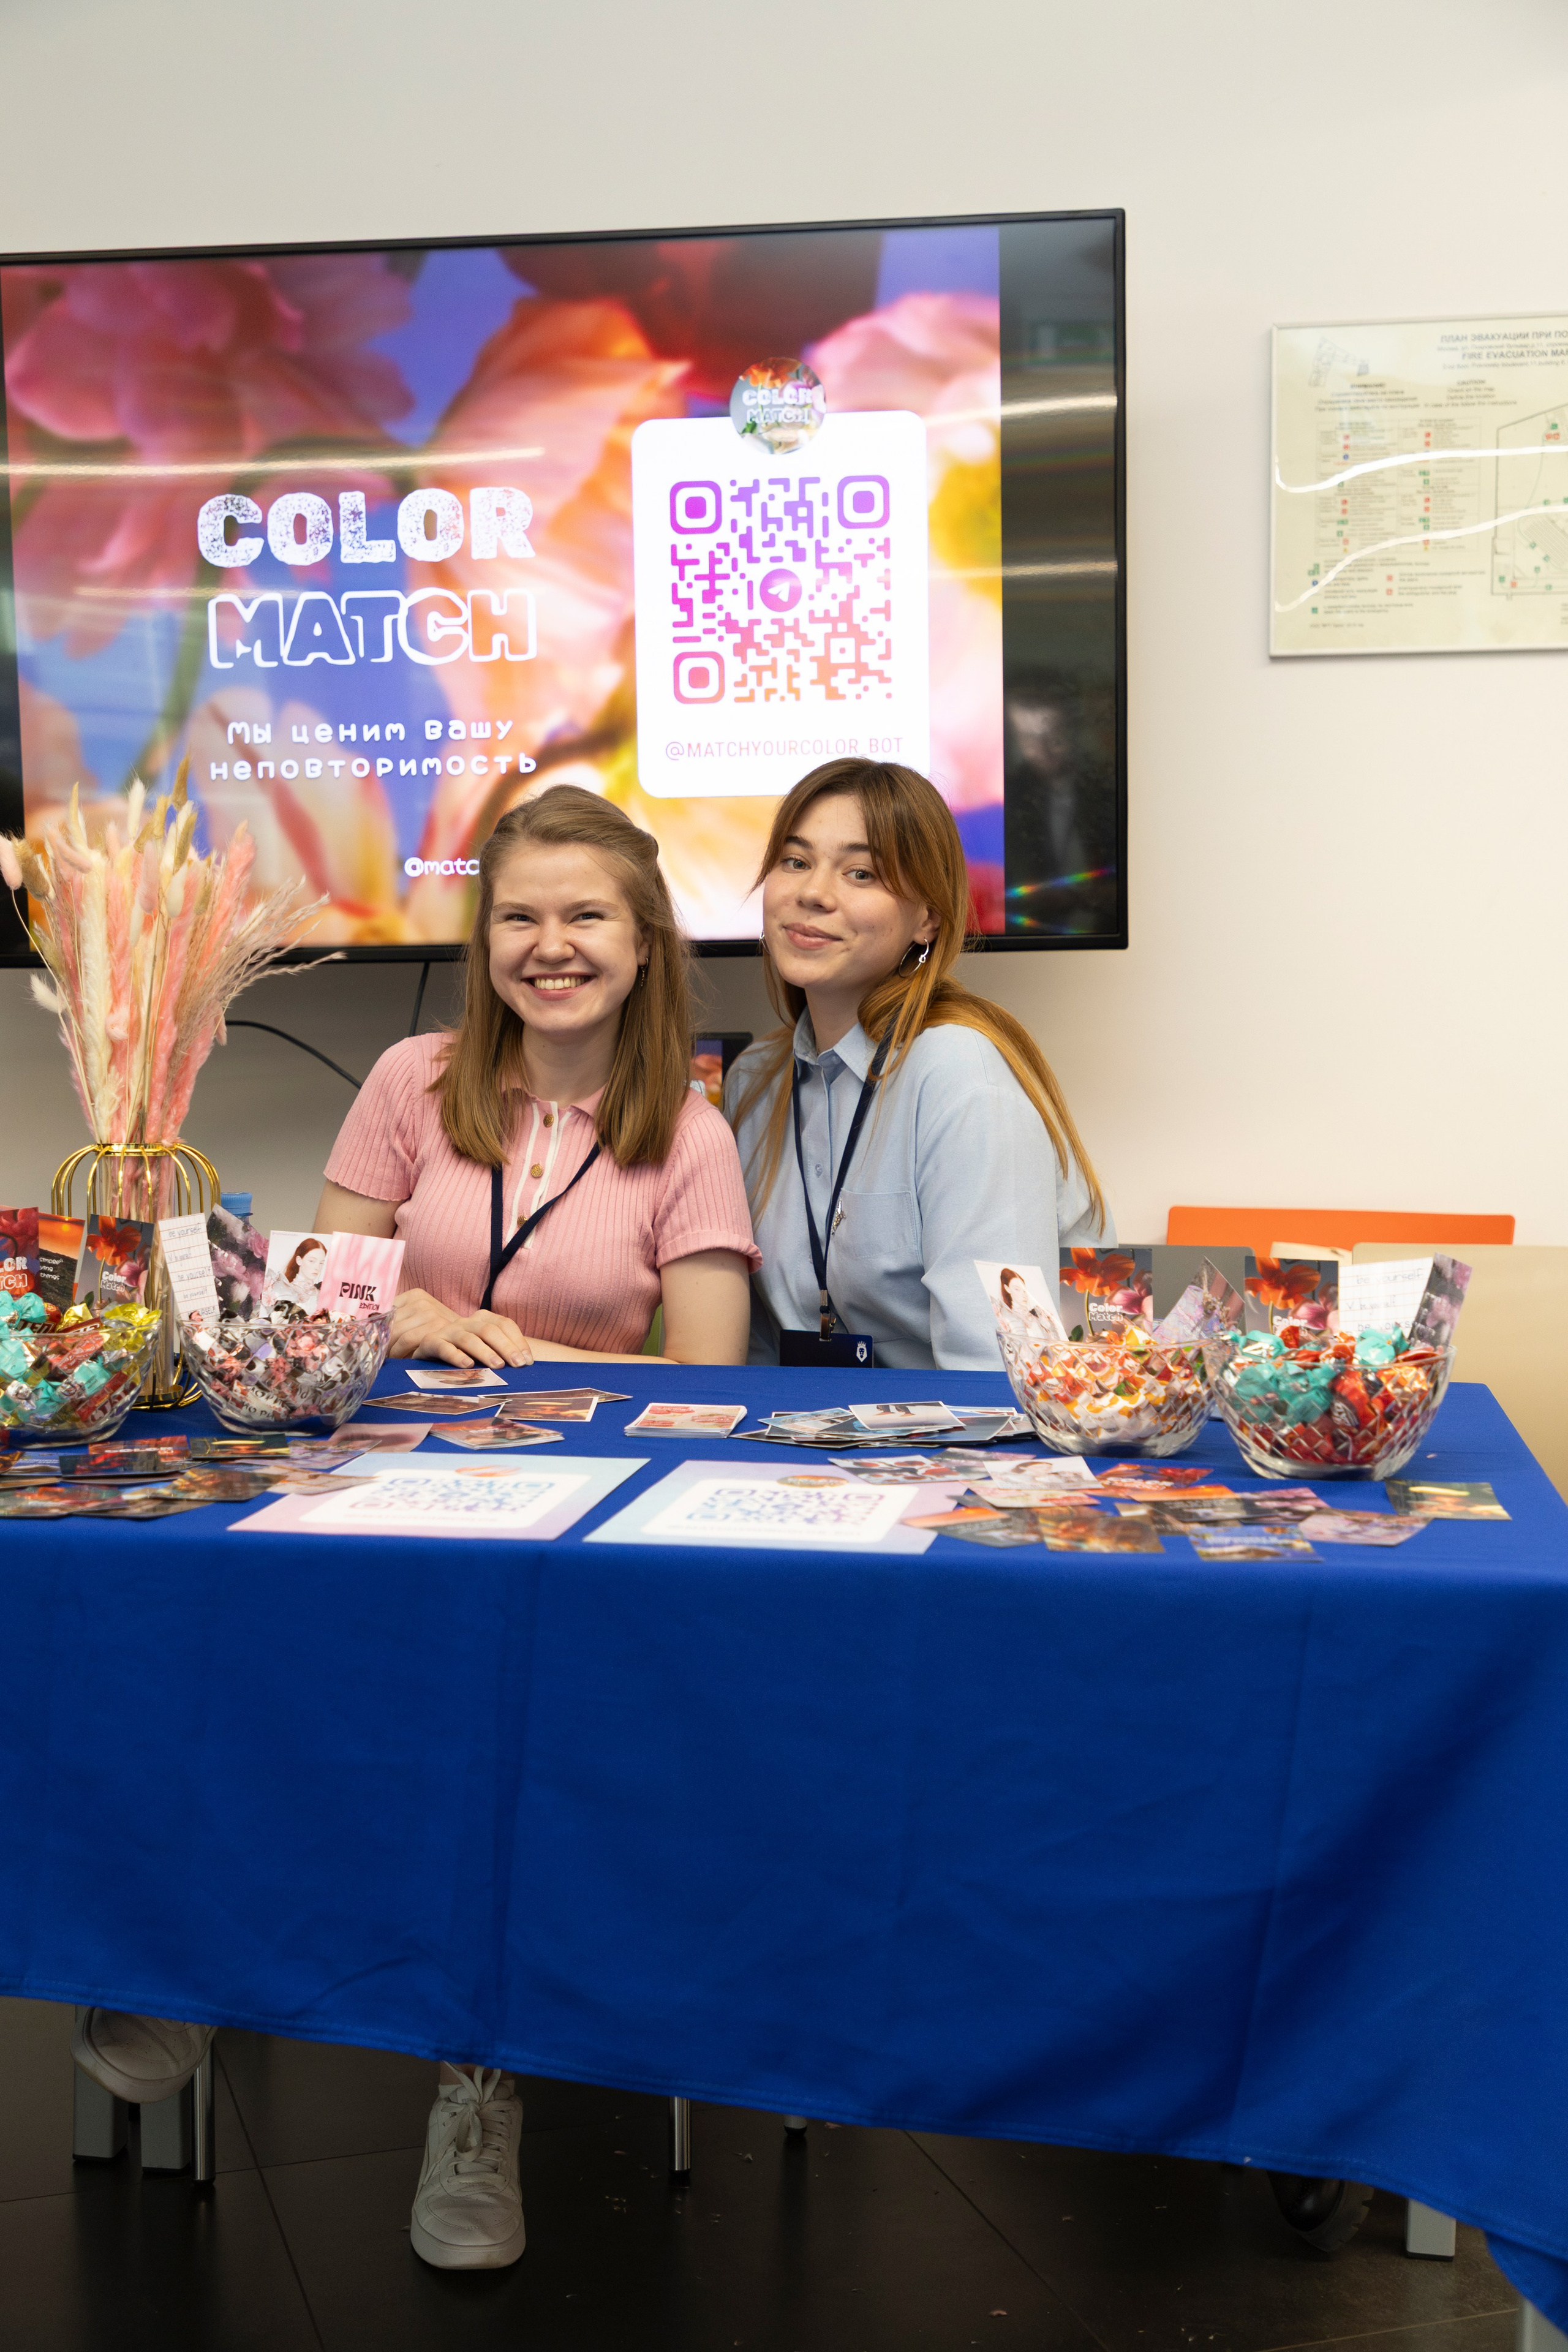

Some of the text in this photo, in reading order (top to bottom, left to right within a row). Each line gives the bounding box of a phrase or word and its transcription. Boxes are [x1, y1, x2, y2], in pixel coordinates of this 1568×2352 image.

[1487, 350, 1548, 360] EVACUATION
[742, 387, 812, 405] COLOR
[747, 406, 810, 424] MATCH
[197, 487, 536, 567] COLOR
[207, 587, 537, 668] MATCH
[292, 722, 405, 744] ценим
[665, 737, 903, 761] @MATCHYOURCOLOR_BOT
[209, 752, 537, 781] неповторимость
[177, 1223, 202, 1241] yourself
[102, 1271, 127, 1283] Color
[1357, 1275, 1370, 1284] be
[100, 1280, 126, 1292] Match
[339, 1282, 377, 1302] PINK
[200, 1306, 216, 1317] URSELF
[359, 1302, 380, 1311] EDITION
[1088, 1303, 1123, 1312] Color
[1088, 1311, 1123, 1321] Match
[1273, 1316, 1308, 1327] Color
